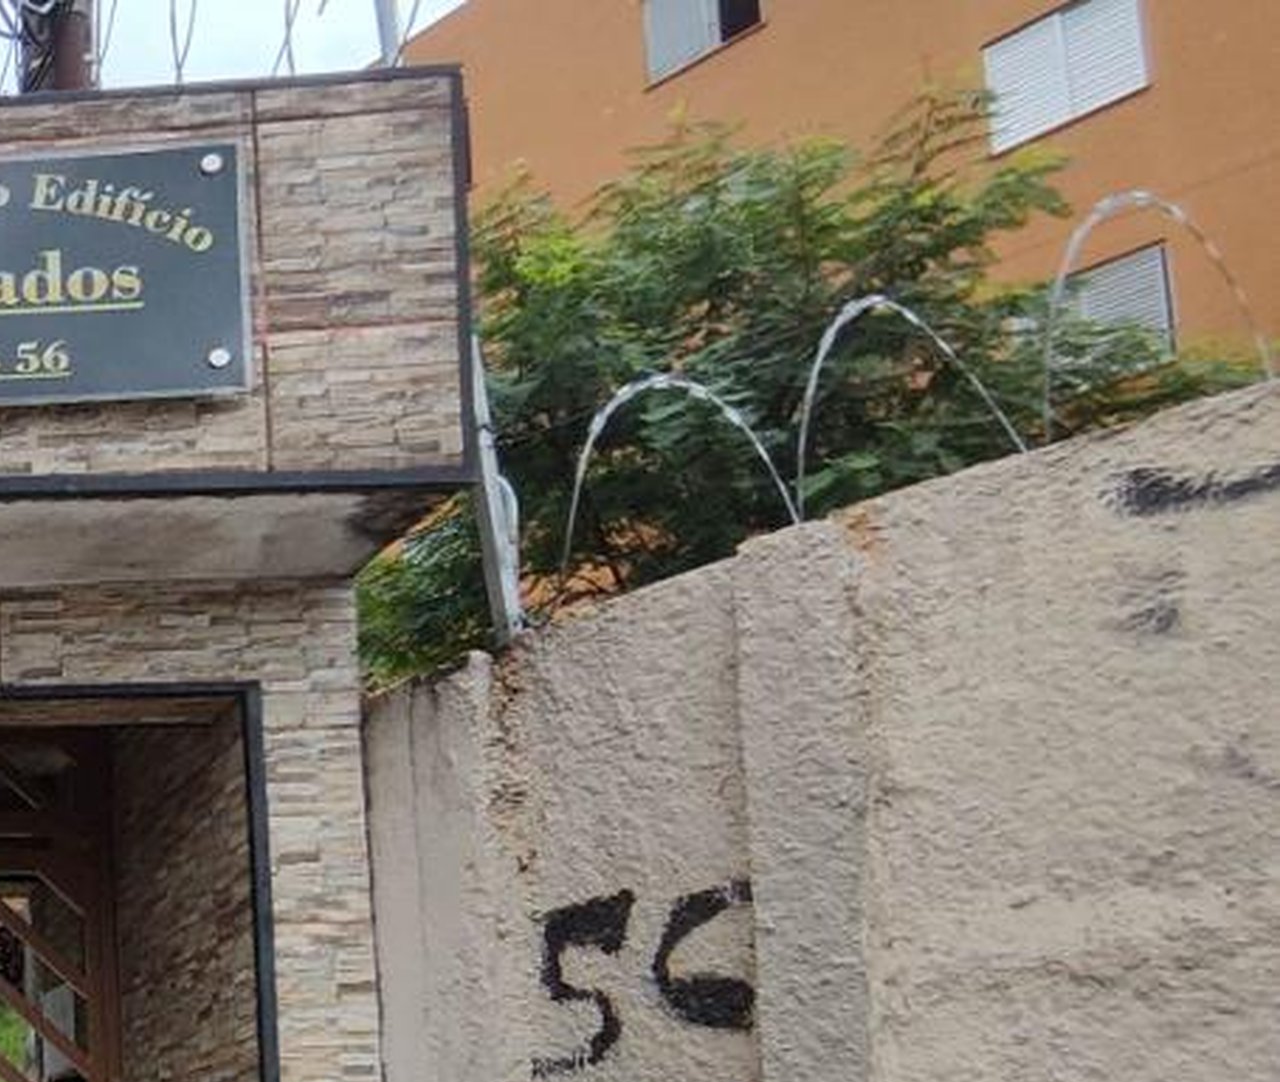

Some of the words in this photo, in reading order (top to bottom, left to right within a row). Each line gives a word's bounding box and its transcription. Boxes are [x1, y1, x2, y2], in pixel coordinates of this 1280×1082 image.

[31, 172, 214, 254] Edifício
[16, 340, 71, 375] 56
[530, 877, 755, 1079] 56
